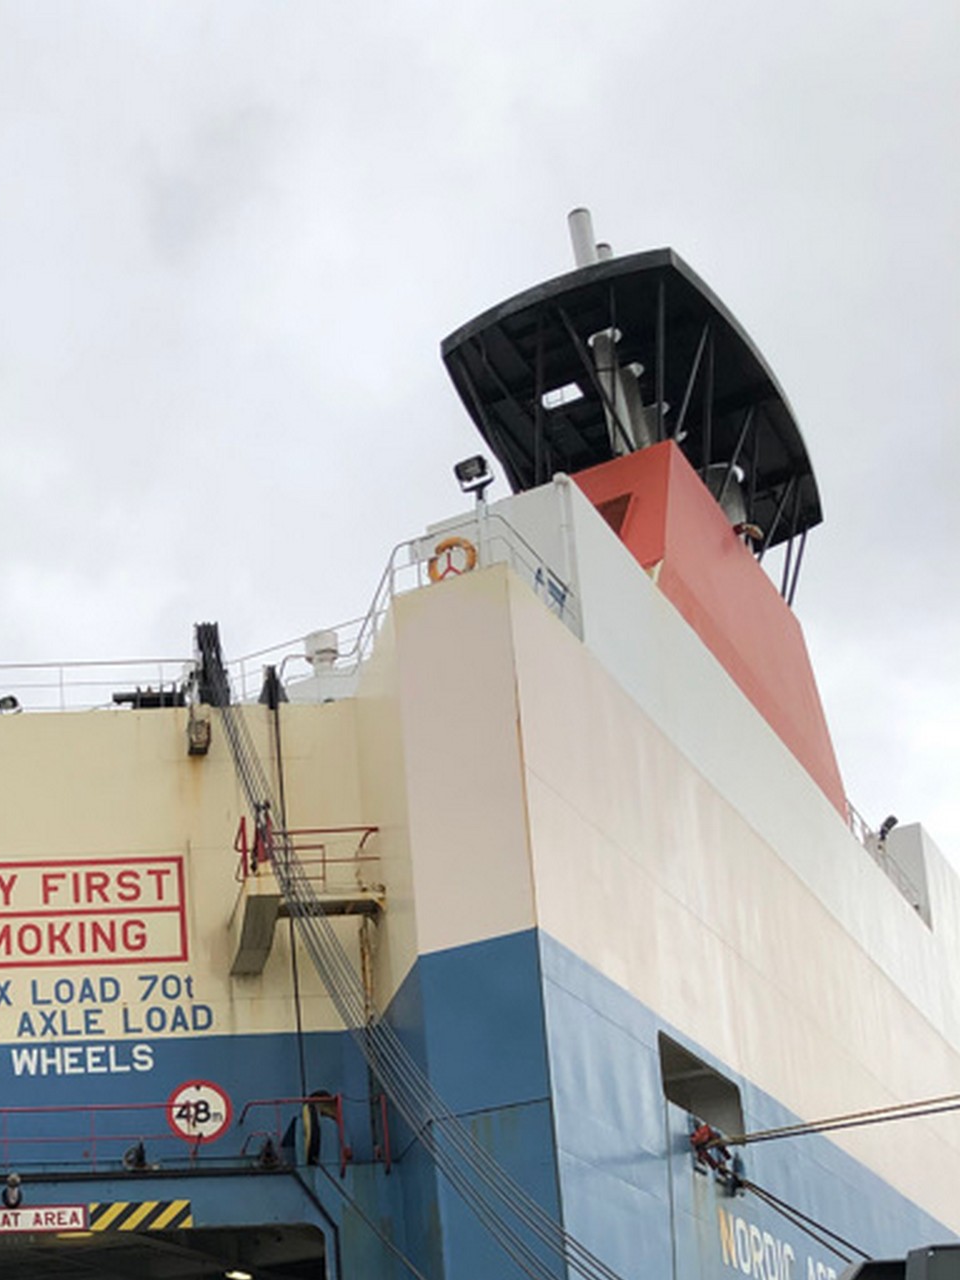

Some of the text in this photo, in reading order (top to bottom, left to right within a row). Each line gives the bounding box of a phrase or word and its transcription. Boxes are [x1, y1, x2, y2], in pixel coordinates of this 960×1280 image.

[41, 868, 172, 906] FIRST
[31, 976, 121, 1005] LOAD
[139, 974, 195, 1001] 70t
[16, 1008, 105, 1037] AXLE
[123, 1004, 213, 1034] LOAD
[11, 1044, 154, 1076] WHEELS
[33, 1209, 82, 1226] AREA
